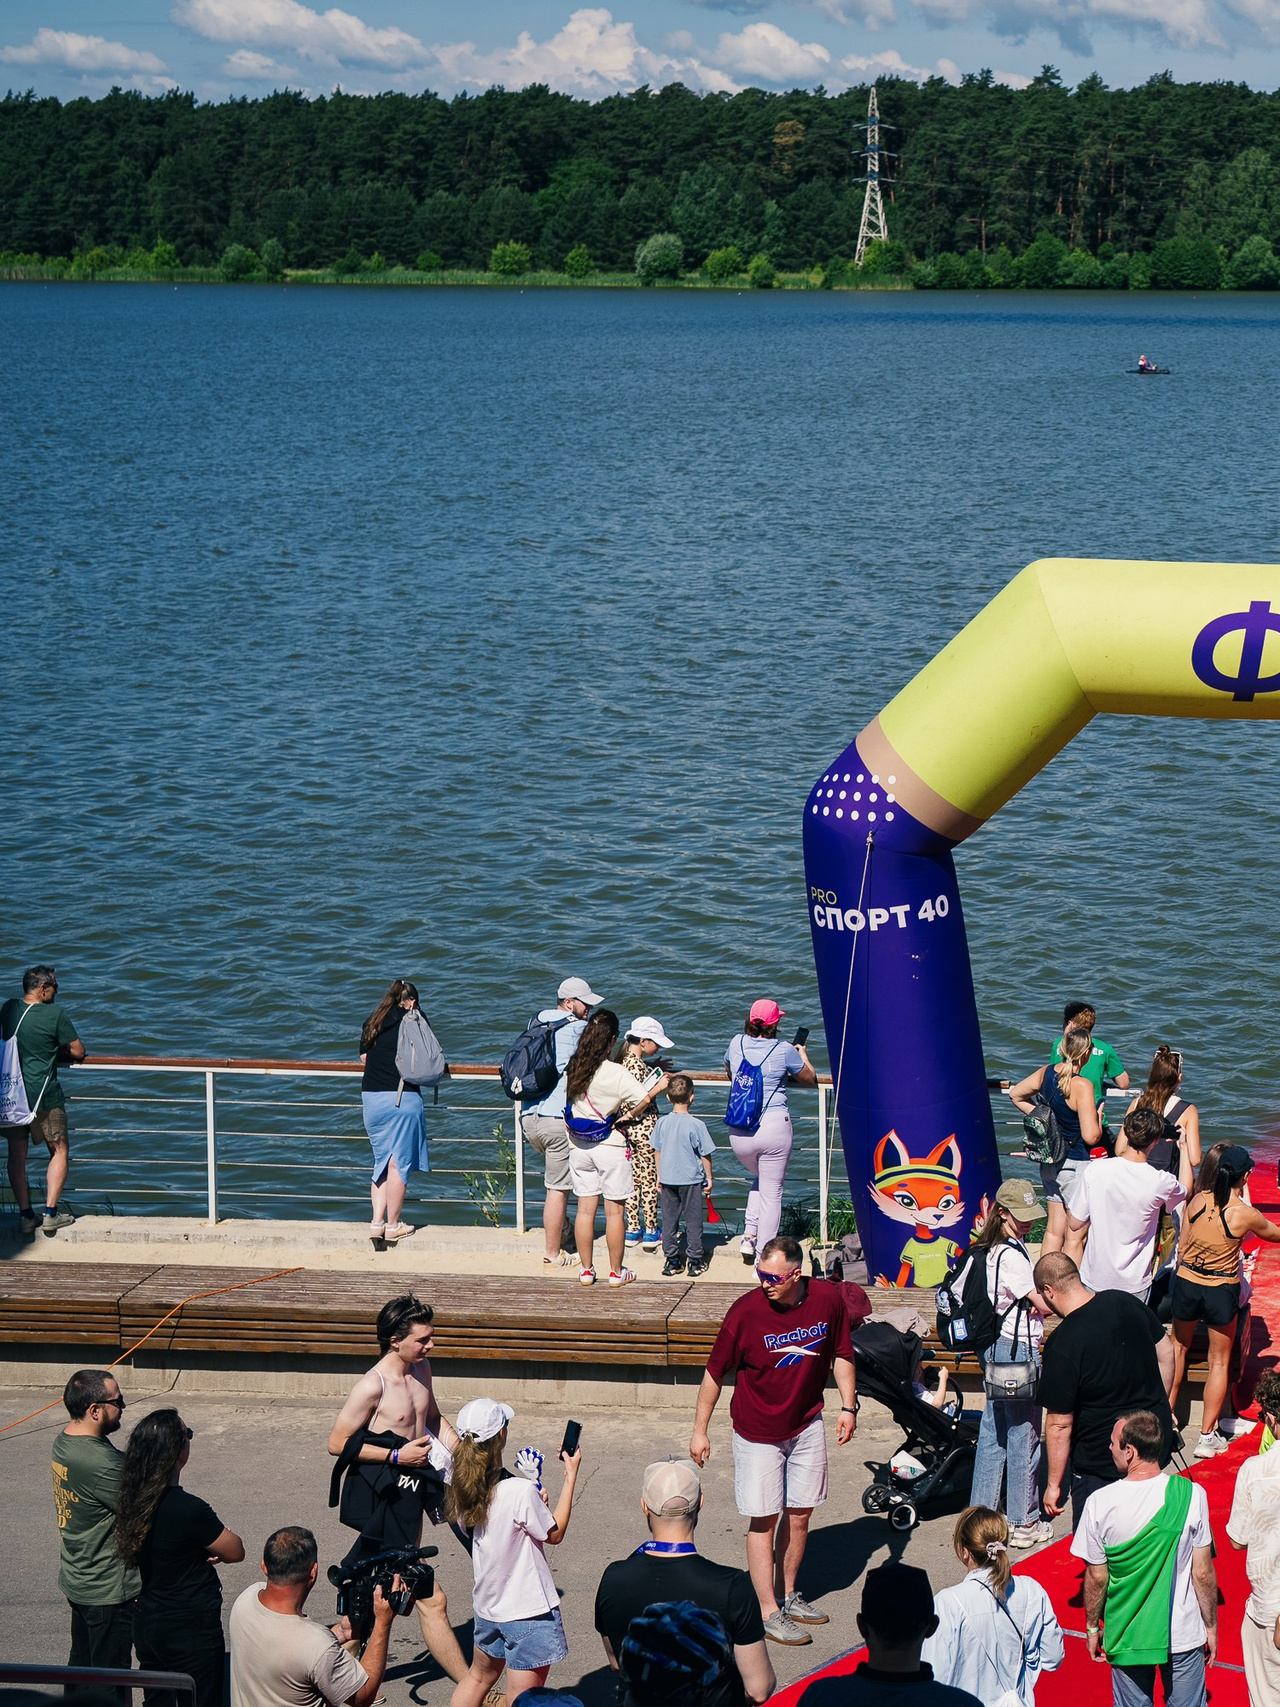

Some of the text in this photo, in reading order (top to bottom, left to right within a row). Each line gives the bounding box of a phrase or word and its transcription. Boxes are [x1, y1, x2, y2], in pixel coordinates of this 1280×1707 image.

[810, 886, 837, 905] PRO
[813, 894, 950, 932] СПОРТ 40
[763, 1321, 828, 1349] Reebok
